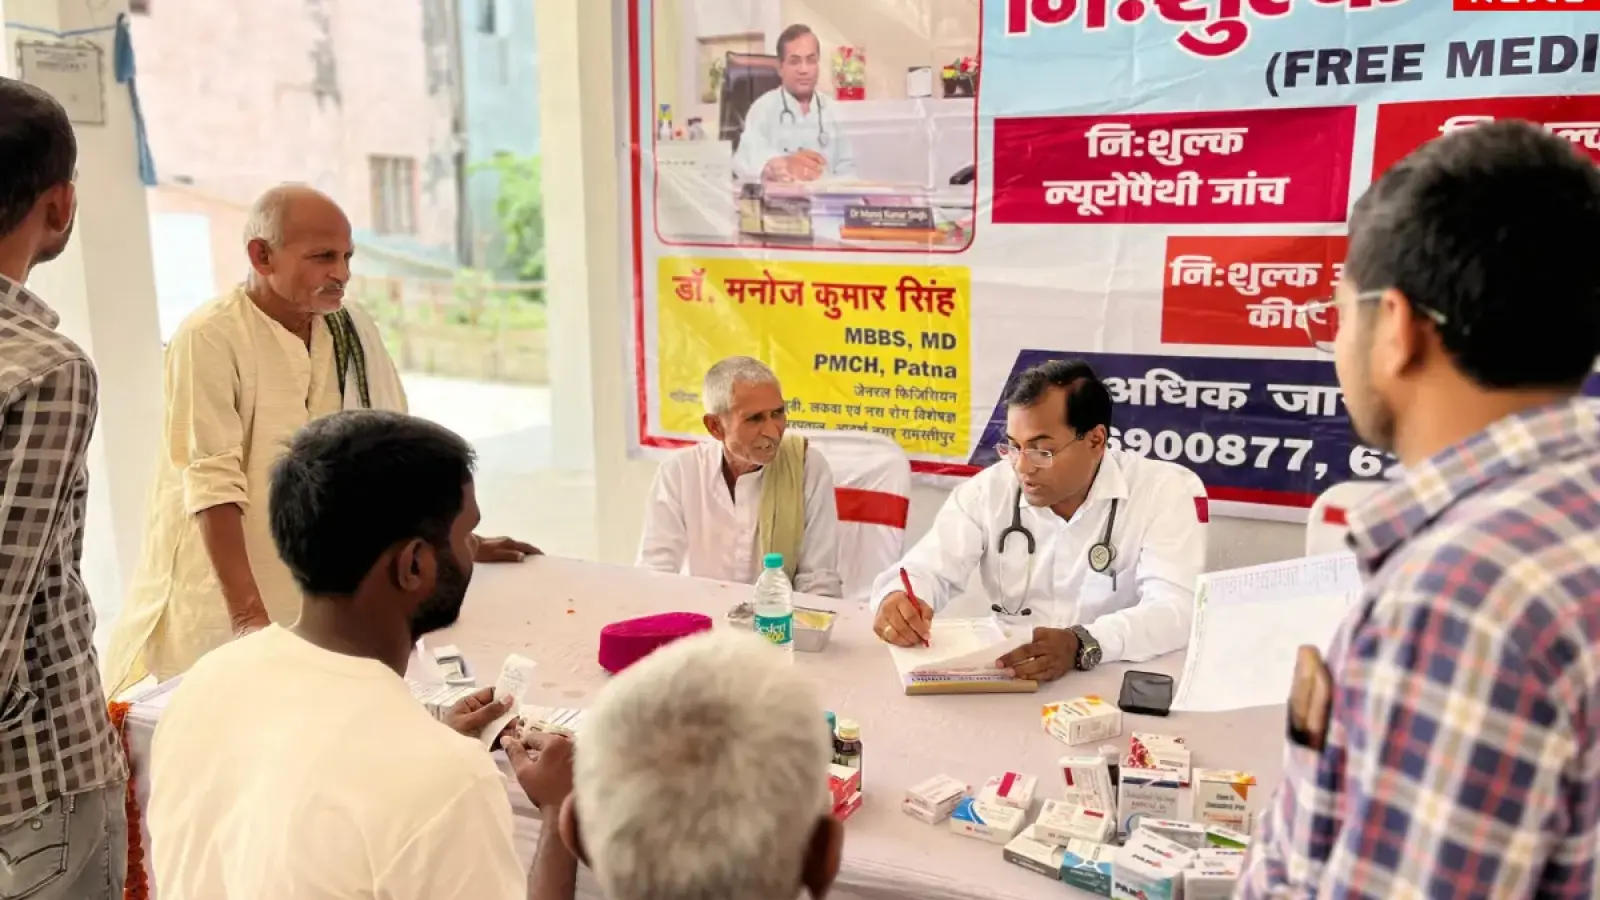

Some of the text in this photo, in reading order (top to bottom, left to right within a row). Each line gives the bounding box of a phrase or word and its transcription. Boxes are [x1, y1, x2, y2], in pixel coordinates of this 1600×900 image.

[1265, 33, 1600, 97] (FREE MEDI
[1085, 122, 1248, 165] नि:शुल्क
[1043, 172, 1291, 215] न्यूरोपैथी जांच
[672, 268, 957, 319] डॉ. मनोज कुमार सिंह
[1169, 254, 1323, 296] नि:शुल्क
[844, 327, 957, 350] MBBS, MD
[813, 353, 957, 379] PMCH, Patna
[1102, 368, 1251, 411] अधिक
[1349, 445, 1397, 477] 6
